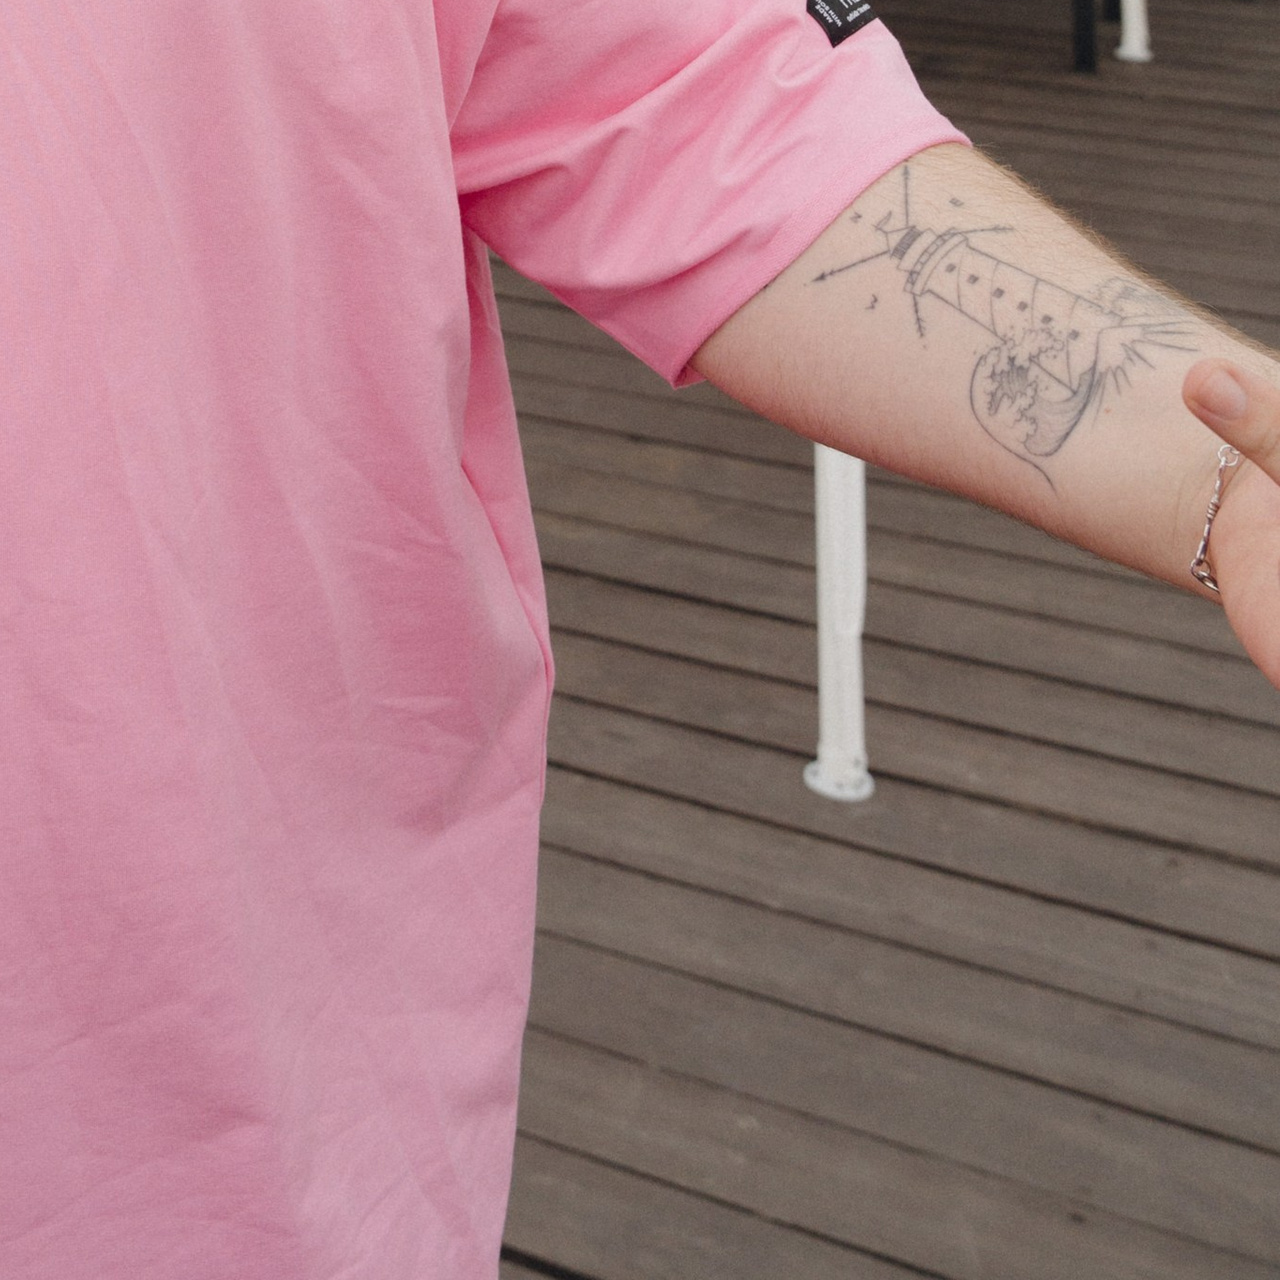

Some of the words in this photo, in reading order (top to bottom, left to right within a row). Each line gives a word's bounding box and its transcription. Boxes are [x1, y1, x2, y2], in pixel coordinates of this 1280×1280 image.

[815, 4, 833, 23] MADE
[828, 10, 842, 27] WITH
[849, 211, 863, 224] N
[864, 293, 878, 310] W
